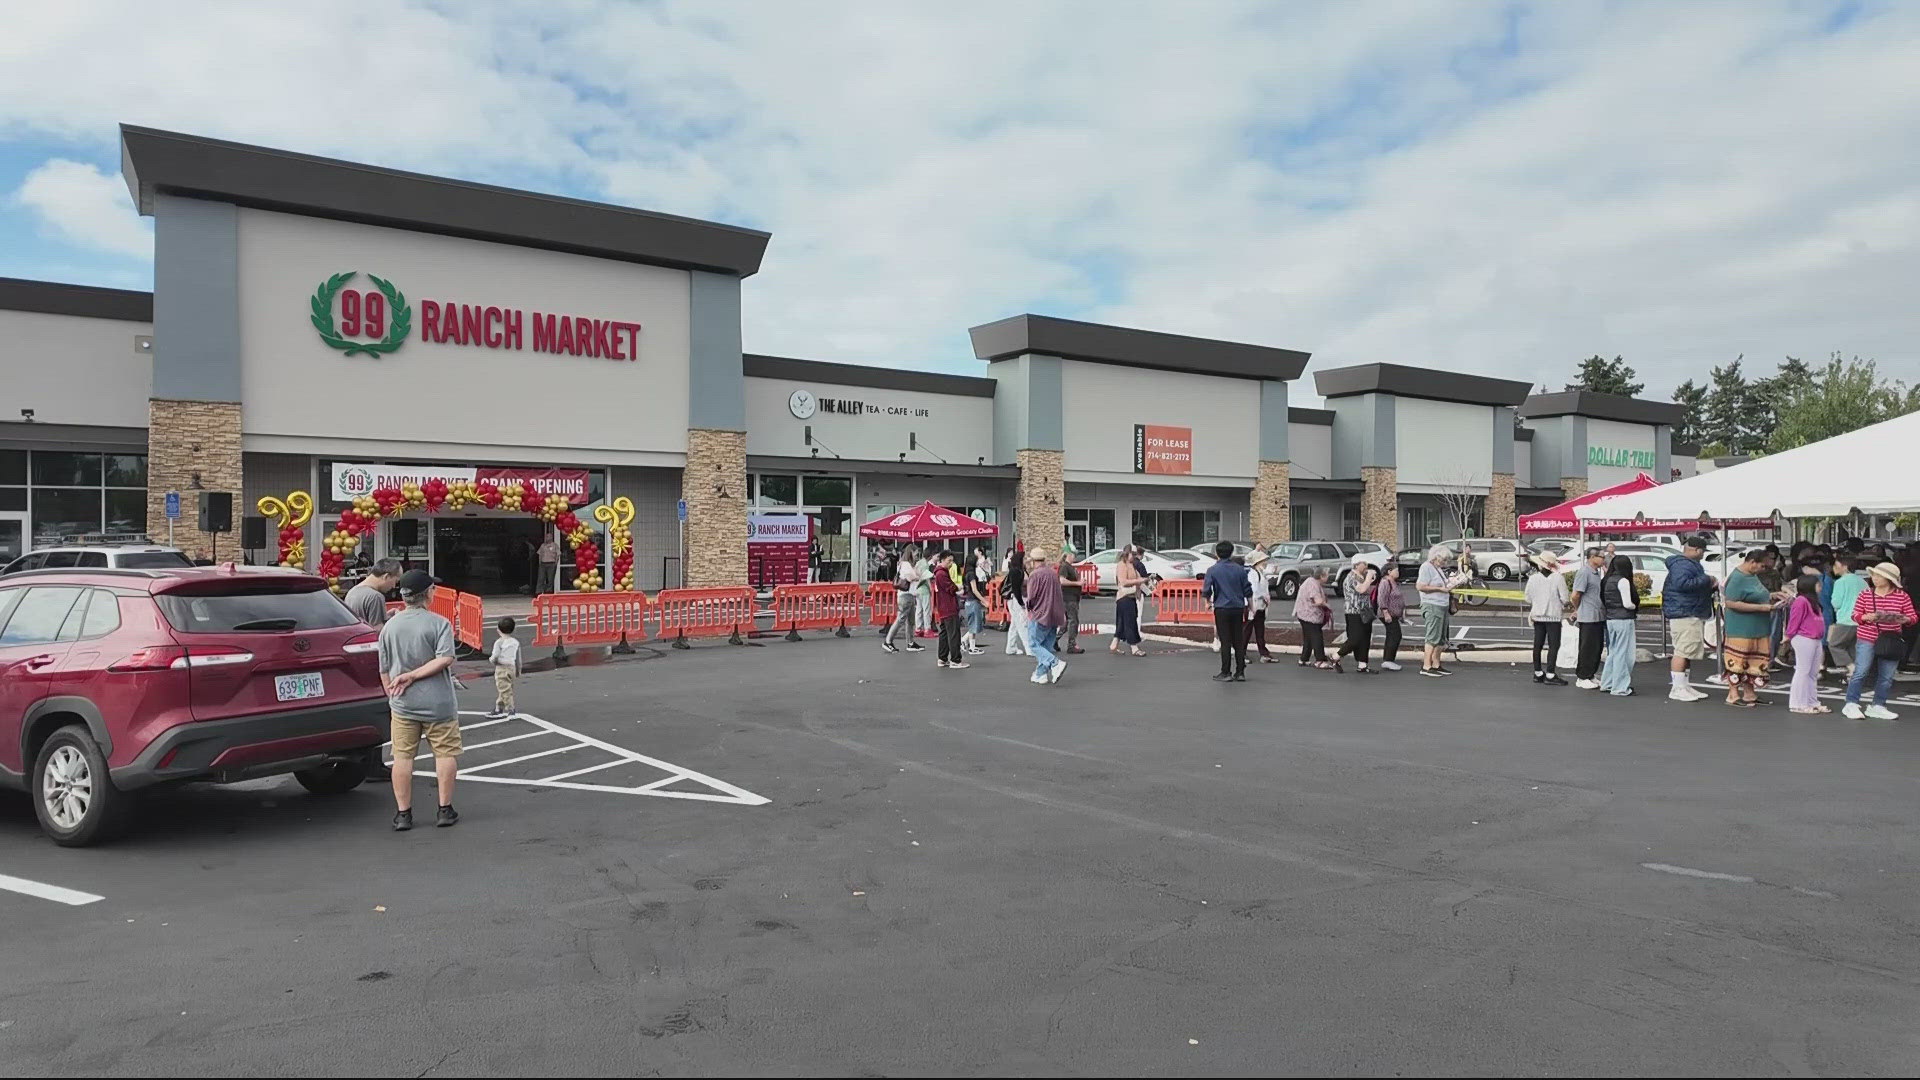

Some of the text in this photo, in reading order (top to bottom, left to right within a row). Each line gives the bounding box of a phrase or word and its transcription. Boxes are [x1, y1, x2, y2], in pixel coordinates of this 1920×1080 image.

[341, 289, 642, 361] 99 RANCH MARKET
[819, 398, 929, 417] THE ALLEY TEA CAFE LIFE
[1147, 438, 1189, 449] FOR LEASE
[1589, 446, 1655, 470] DOLLAR TREE
[348, 474, 364, 491] 99
[529, 478, 584, 495] OPENING
[758, 524, 780, 535] RANCH
[781, 524, 807, 535] MARKET
[279, 678, 320, 695] 639 PNF
